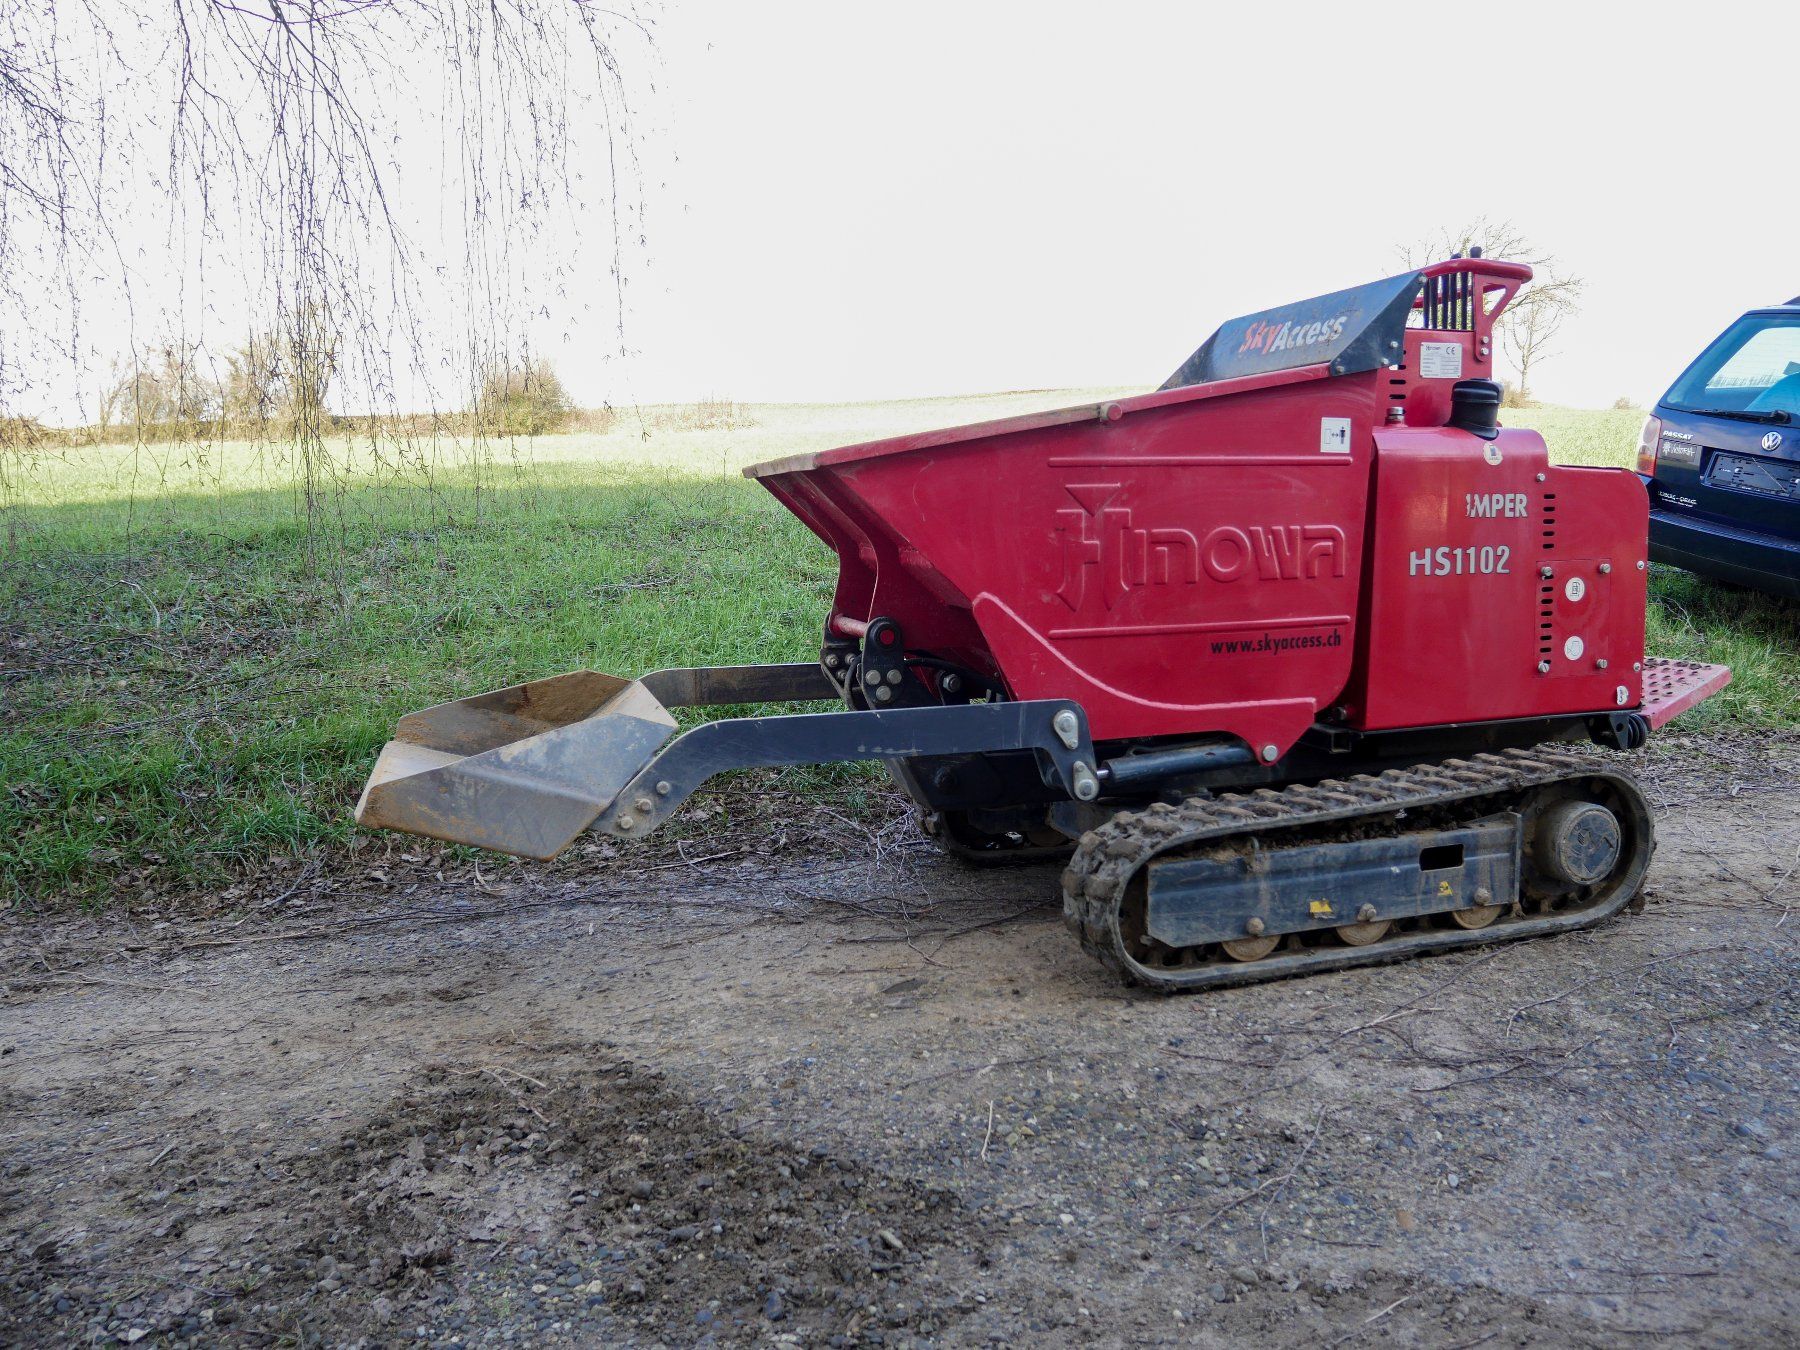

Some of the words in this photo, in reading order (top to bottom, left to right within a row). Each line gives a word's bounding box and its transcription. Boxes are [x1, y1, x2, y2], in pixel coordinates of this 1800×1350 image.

[1238, 316, 1348, 355] SkyAccess
[1662, 430, 1693, 440] PASSAT
[1409, 545, 1511, 576] HS1102
[1211, 628, 1342, 656] www.skyaccess.ch
